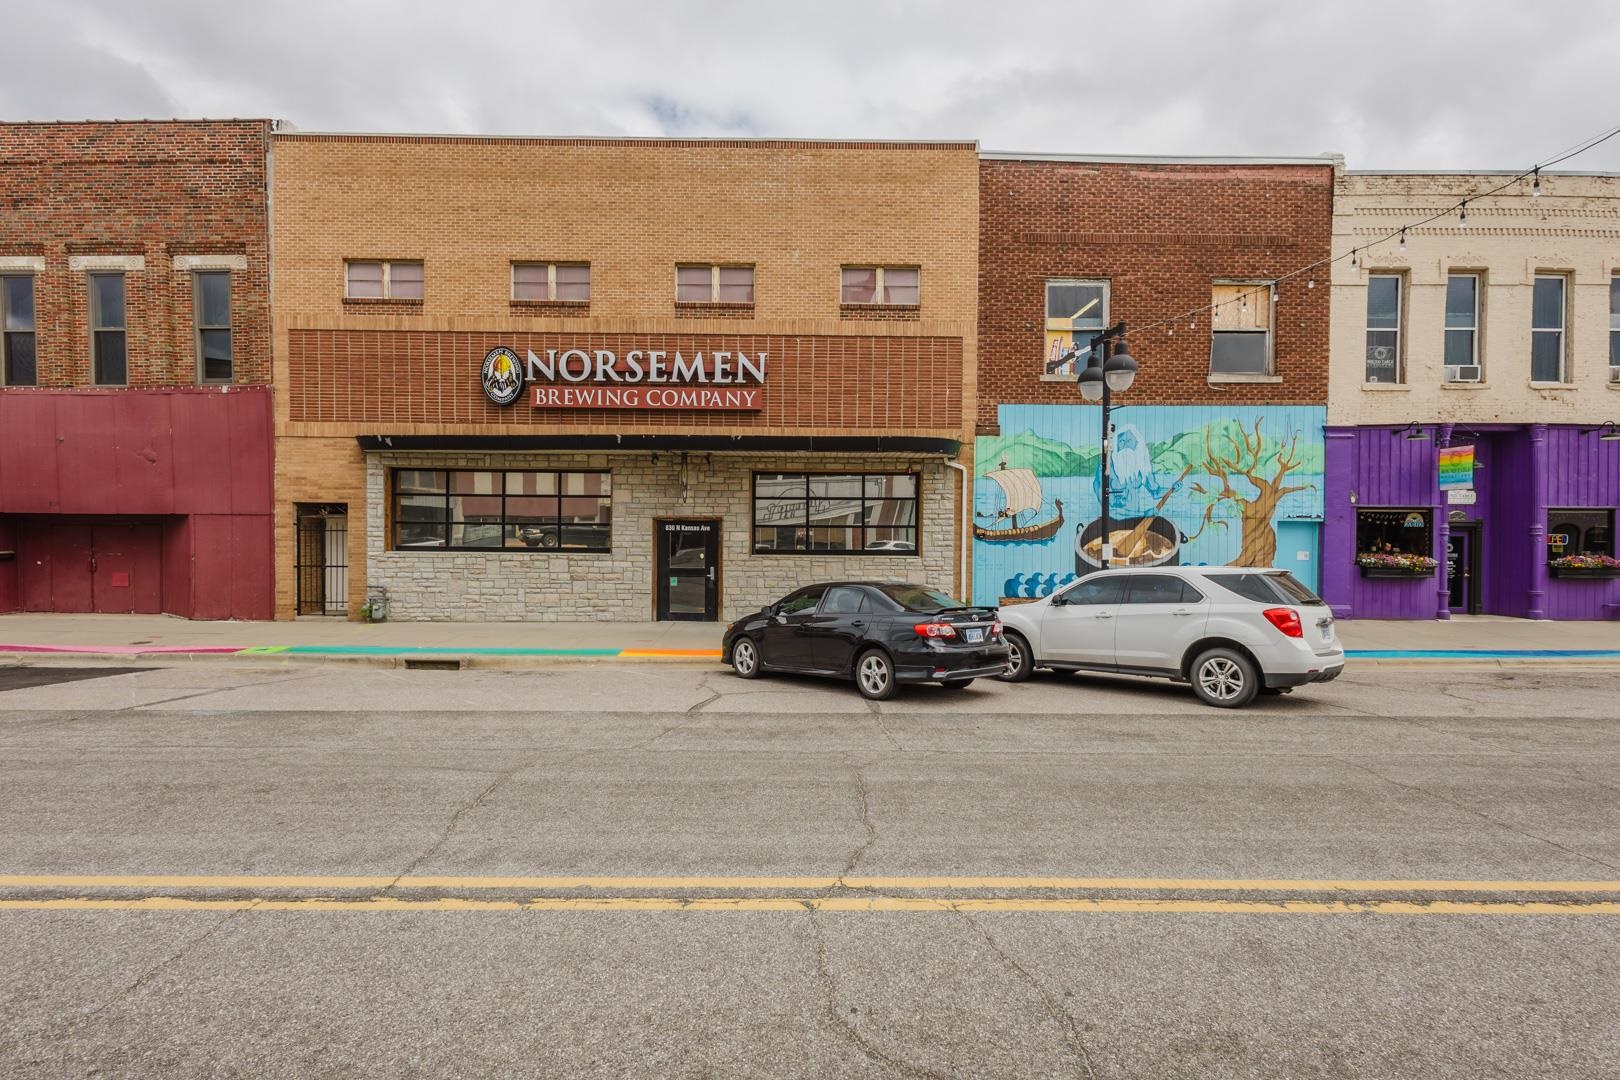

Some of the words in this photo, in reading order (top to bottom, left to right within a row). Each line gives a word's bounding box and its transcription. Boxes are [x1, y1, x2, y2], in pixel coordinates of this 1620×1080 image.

[505, 350, 521, 374] BREWING
[524, 350, 767, 384] NORSEMEN
[490, 392, 514, 401] COMPANY
[536, 389, 638, 406] BREWING
[646, 390, 756, 407] COMPANY
